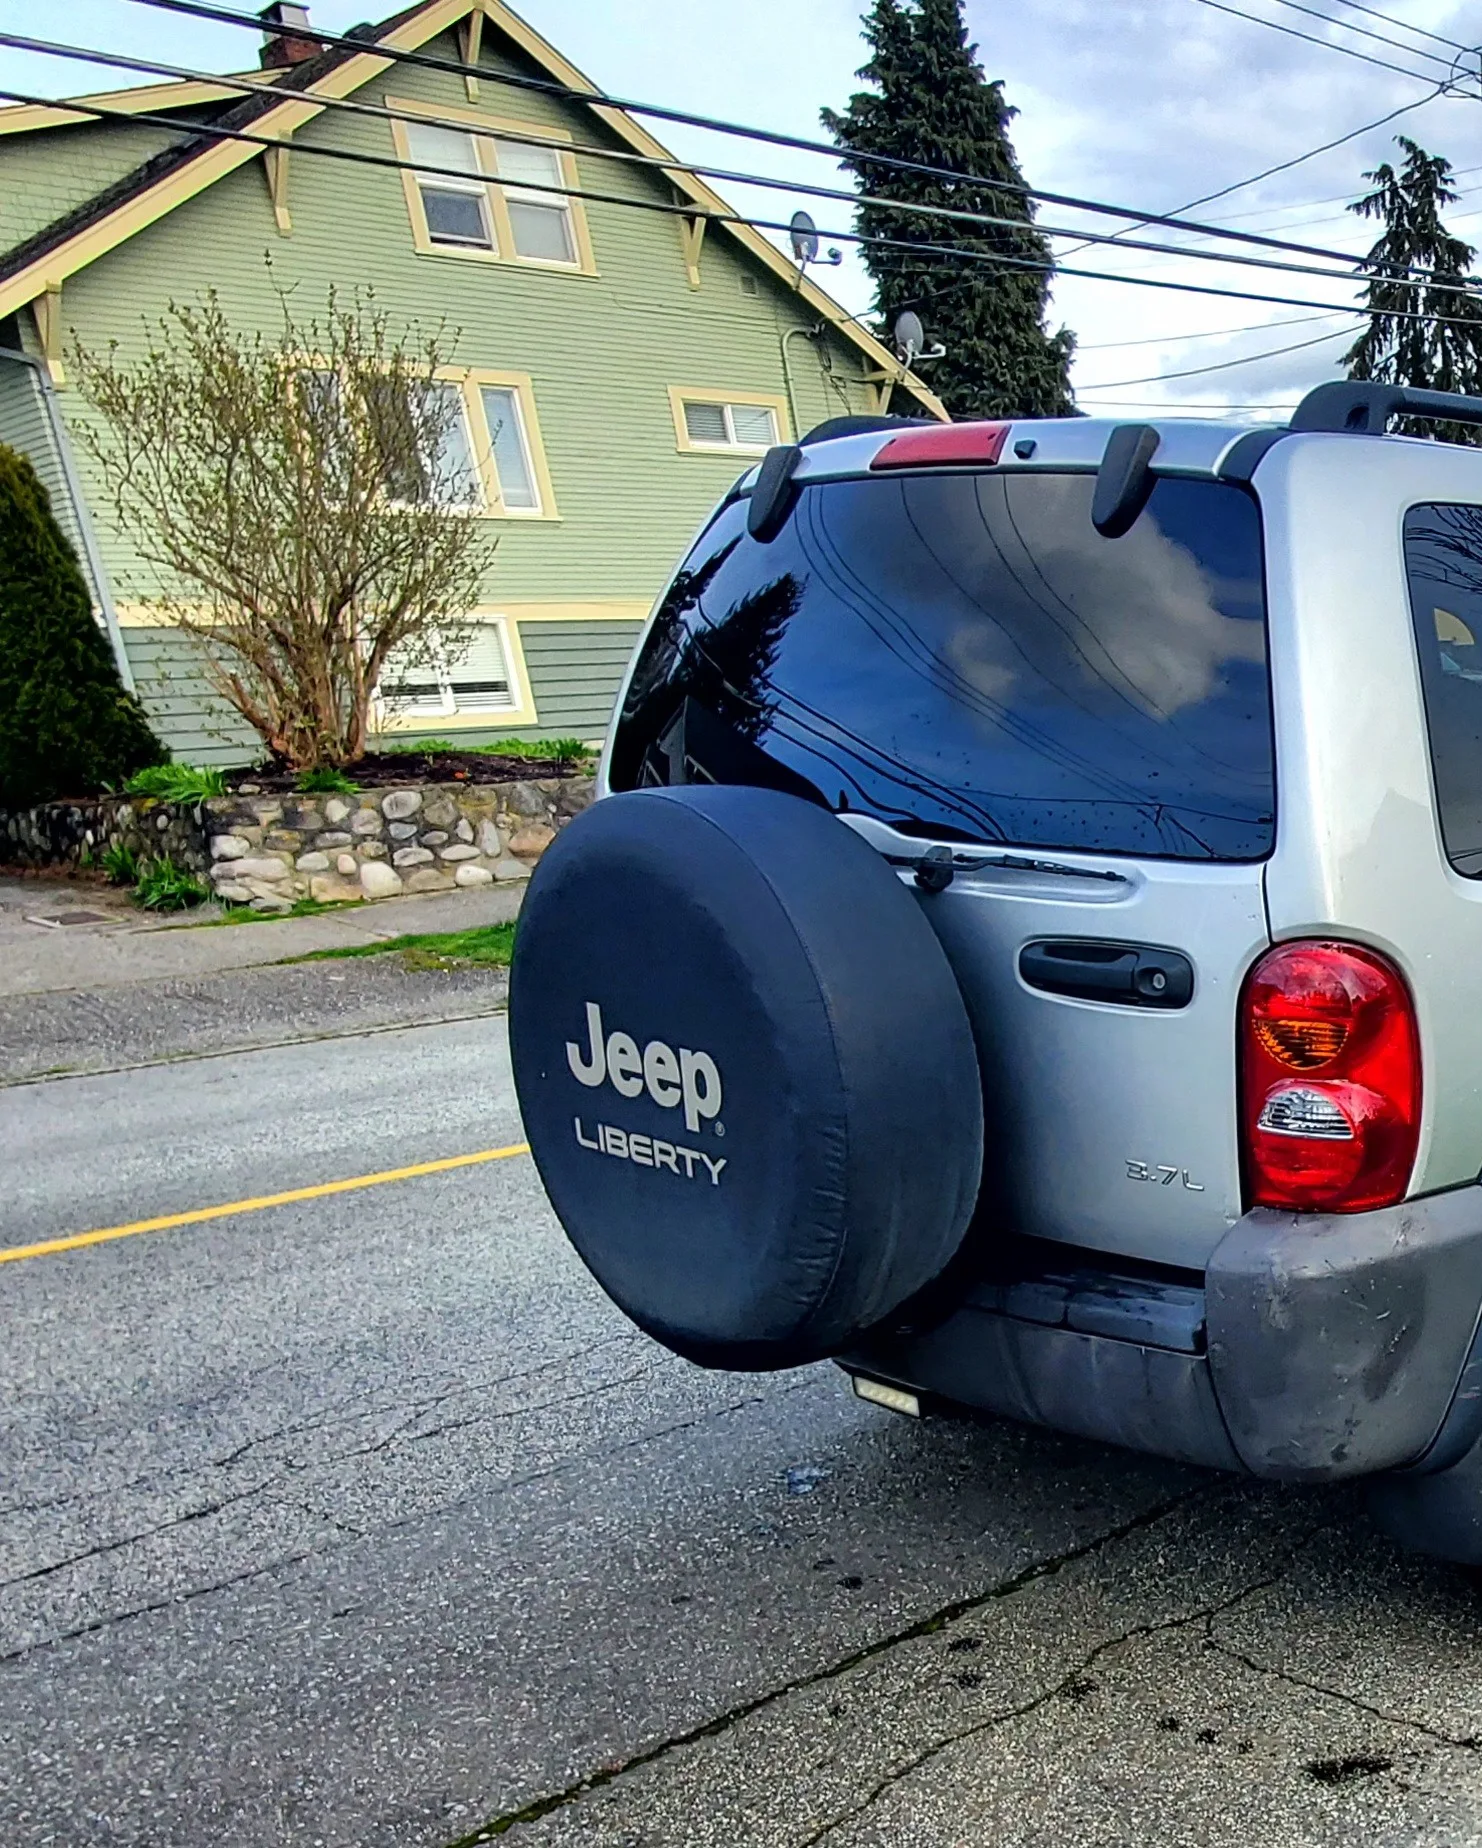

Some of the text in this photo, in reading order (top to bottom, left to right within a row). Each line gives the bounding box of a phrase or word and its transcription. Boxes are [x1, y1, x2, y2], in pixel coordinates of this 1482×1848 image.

[566, 1001, 722, 1132] Jeep
[574, 1117, 727, 1185] LIBERTY
[1125, 1159, 1205, 1191] 3.7L
